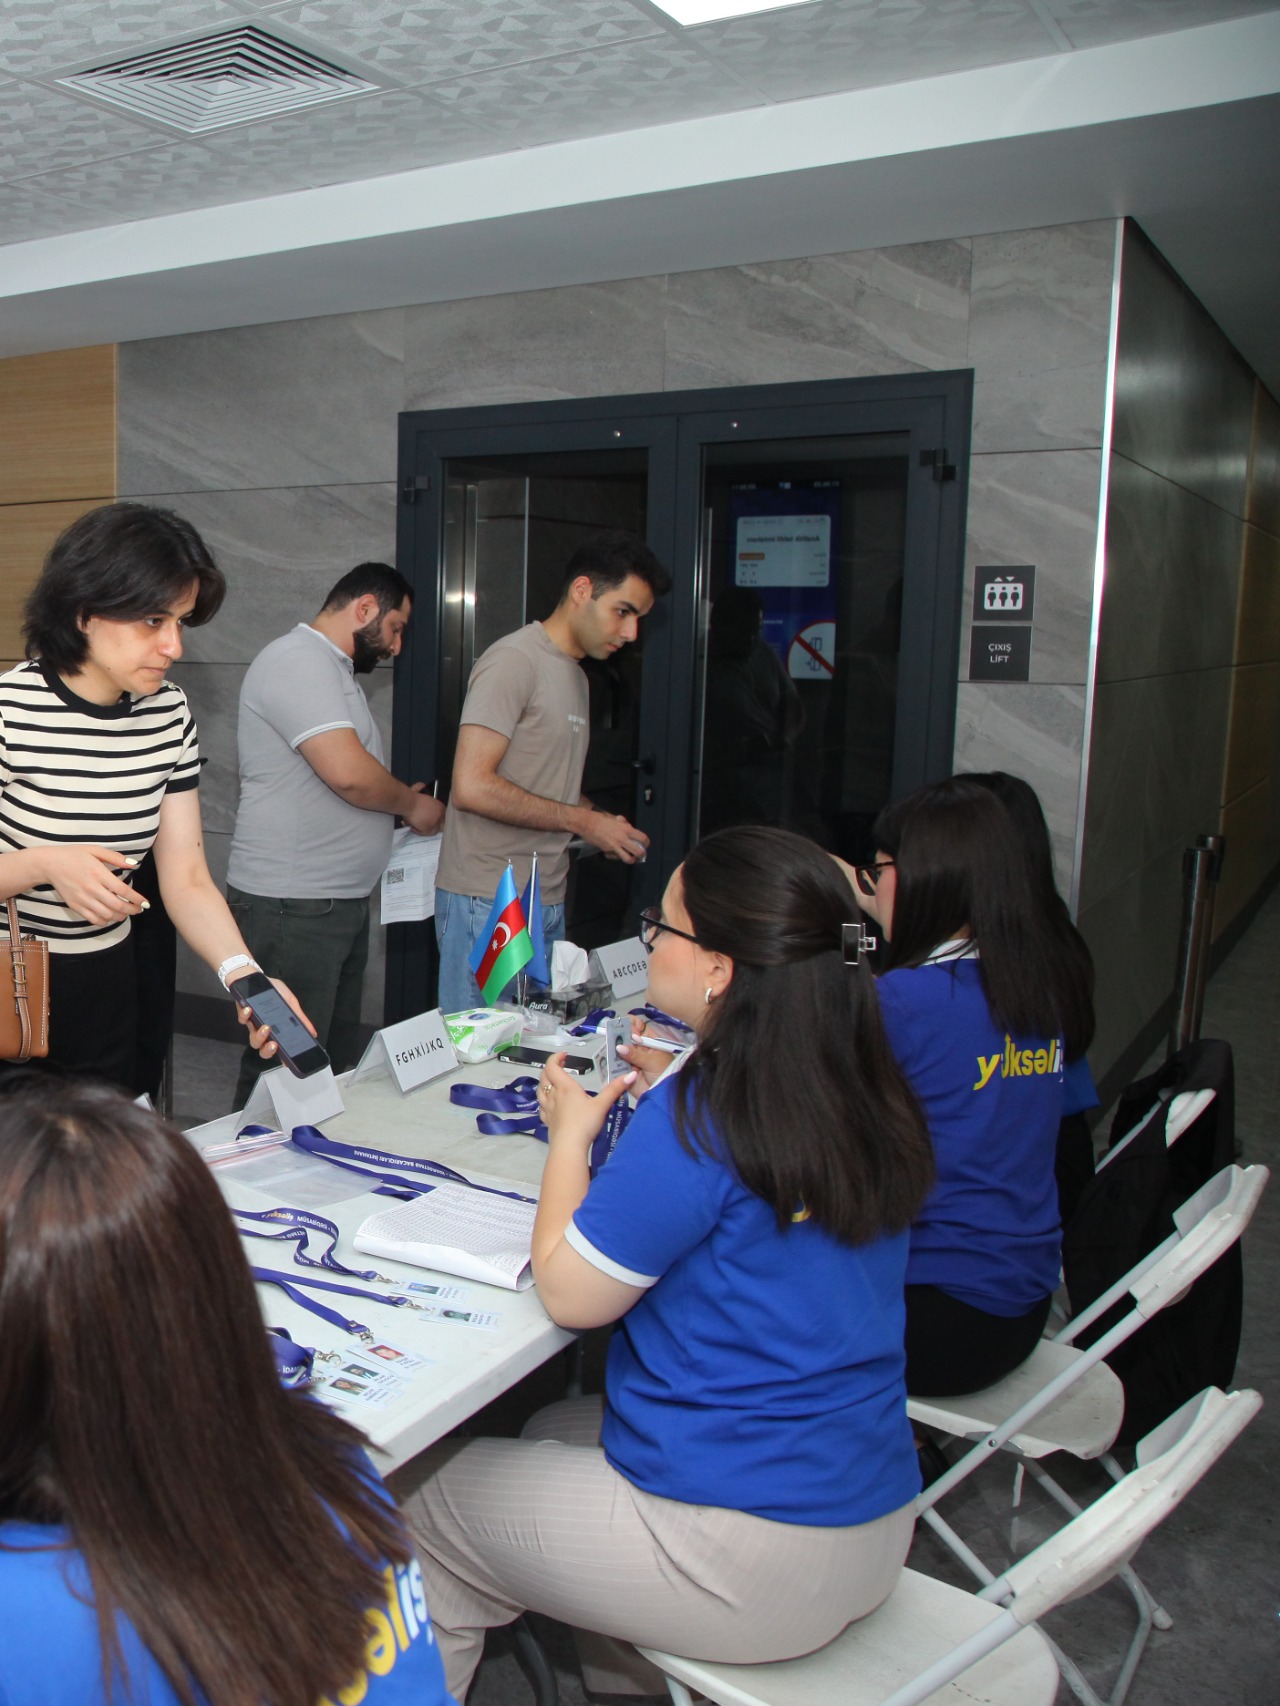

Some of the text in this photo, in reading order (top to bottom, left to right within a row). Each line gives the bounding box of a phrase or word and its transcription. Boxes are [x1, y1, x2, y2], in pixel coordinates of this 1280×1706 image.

[988, 643, 1012, 653] ÇIXIŞ
[990, 654, 1009, 663] LİFT
[528, 1002, 548, 1011] Aura
[395, 1037, 444, 1066] FGHXİJKQ
[973, 1032, 1063, 1091] yüksəli
